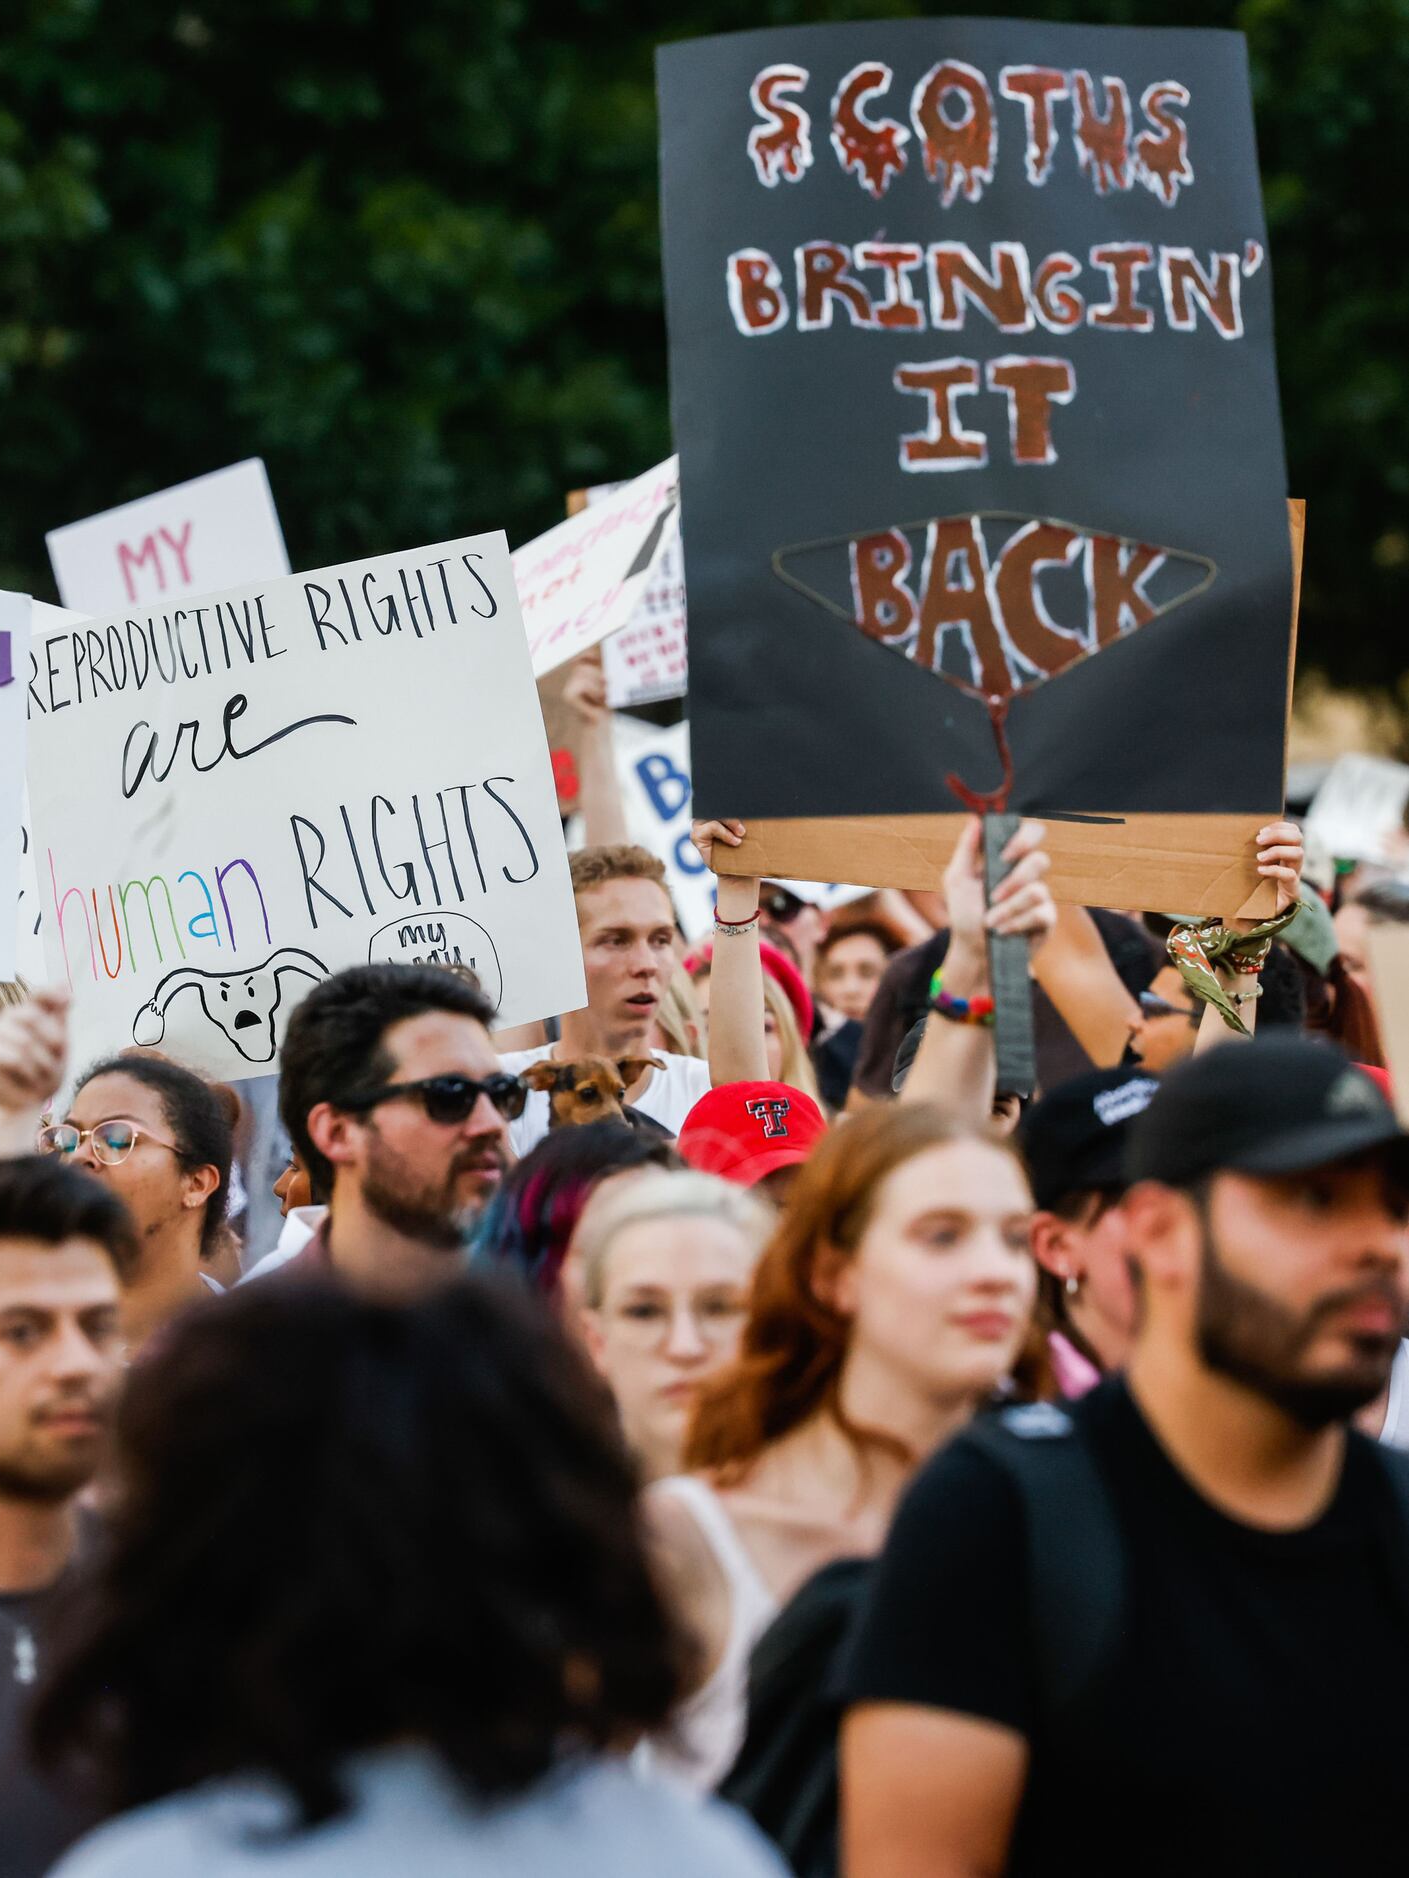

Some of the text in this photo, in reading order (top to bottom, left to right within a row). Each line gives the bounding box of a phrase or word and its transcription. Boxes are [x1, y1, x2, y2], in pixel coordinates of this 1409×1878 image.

[748, 58, 1194, 209] SCOTUS
[727, 236, 1264, 340] BRINGIN'
[894, 355, 1076, 473] IT
[116, 521, 193, 602] MY
[849, 514, 1169, 701] BACK
[26, 593, 289, 720] REPRODUCTIVE
[303, 553, 498, 651] RIGHTS
[122, 693, 358, 799] are
[48, 848, 272, 991] human
[290, 776, 540, 929] RIGHTS
[397, 922, 447, 952] my
